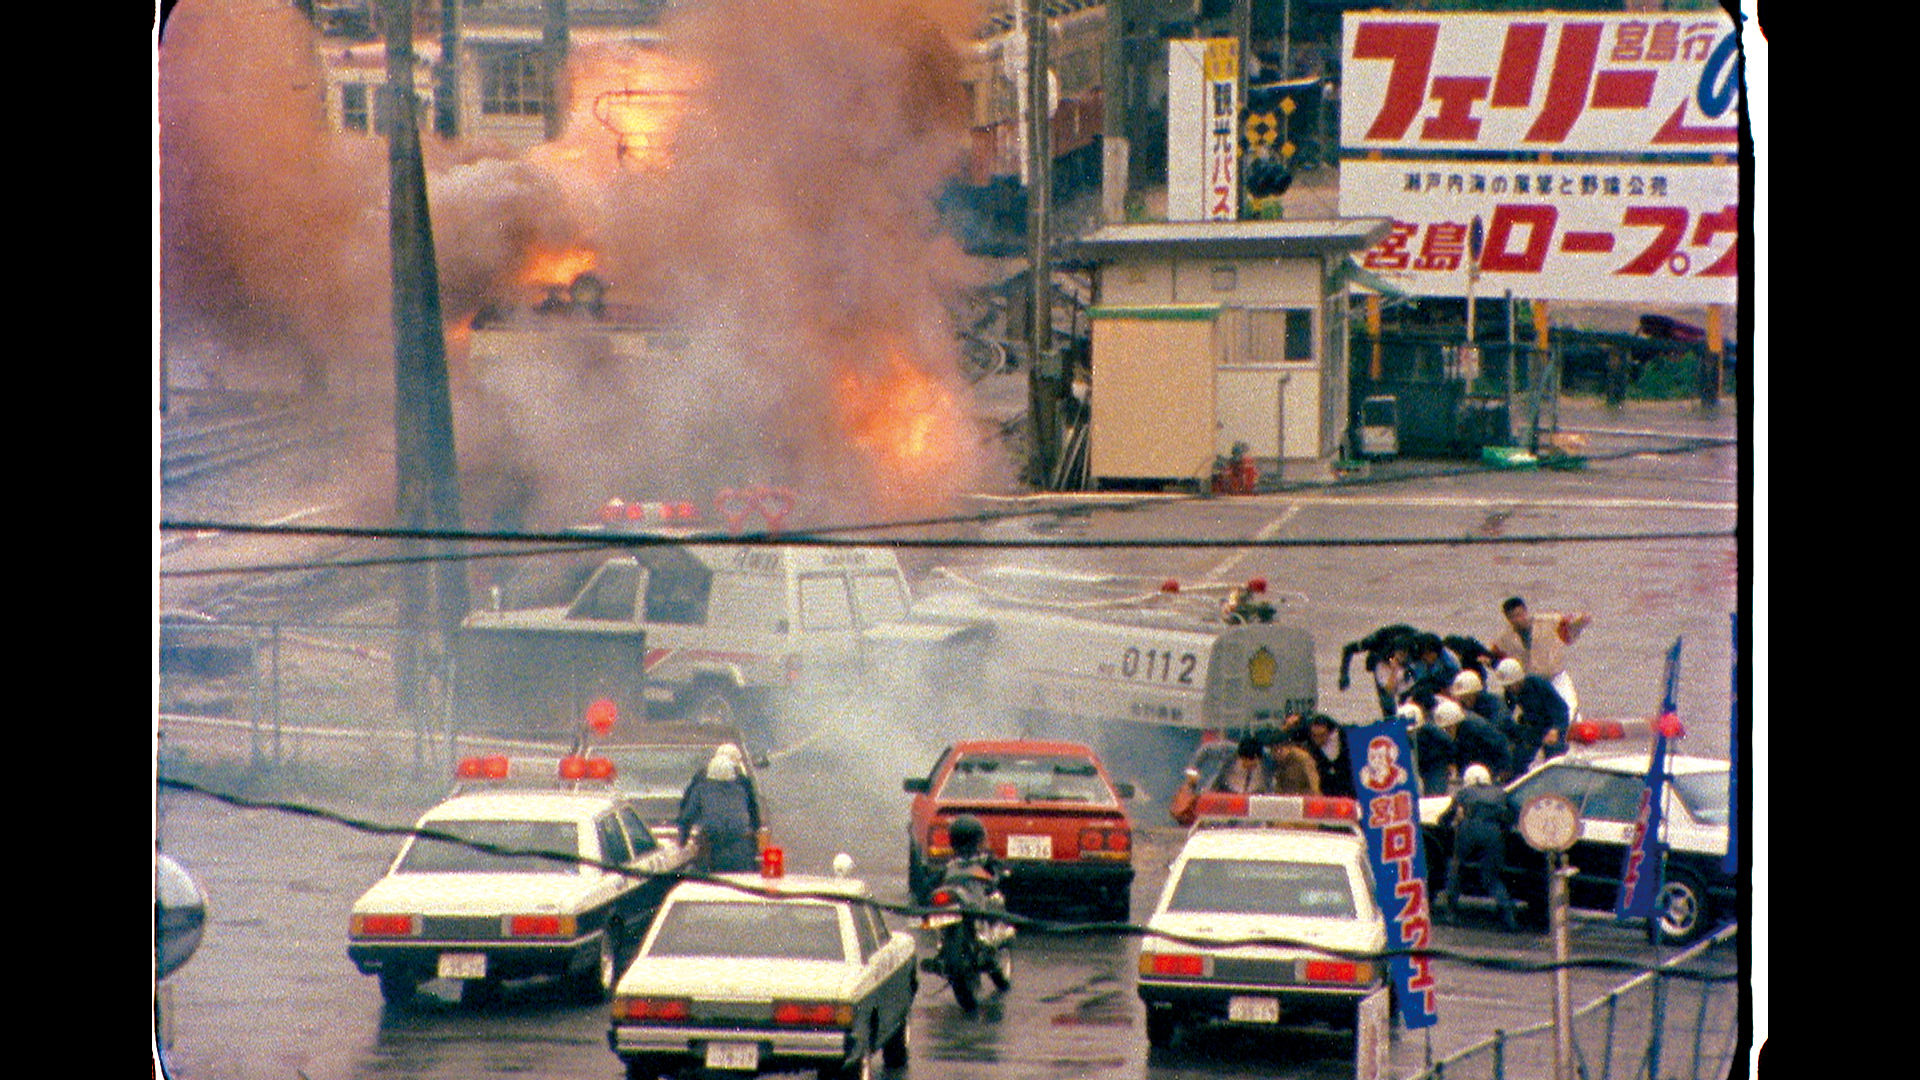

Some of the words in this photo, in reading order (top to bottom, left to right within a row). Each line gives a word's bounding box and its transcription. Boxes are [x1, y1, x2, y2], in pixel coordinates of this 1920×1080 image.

[1611, 19, 1718, 62] 宮島行
[1212, 82, 1232, 221] 観光バス
[1121, 646, 1197, 685] 0112
